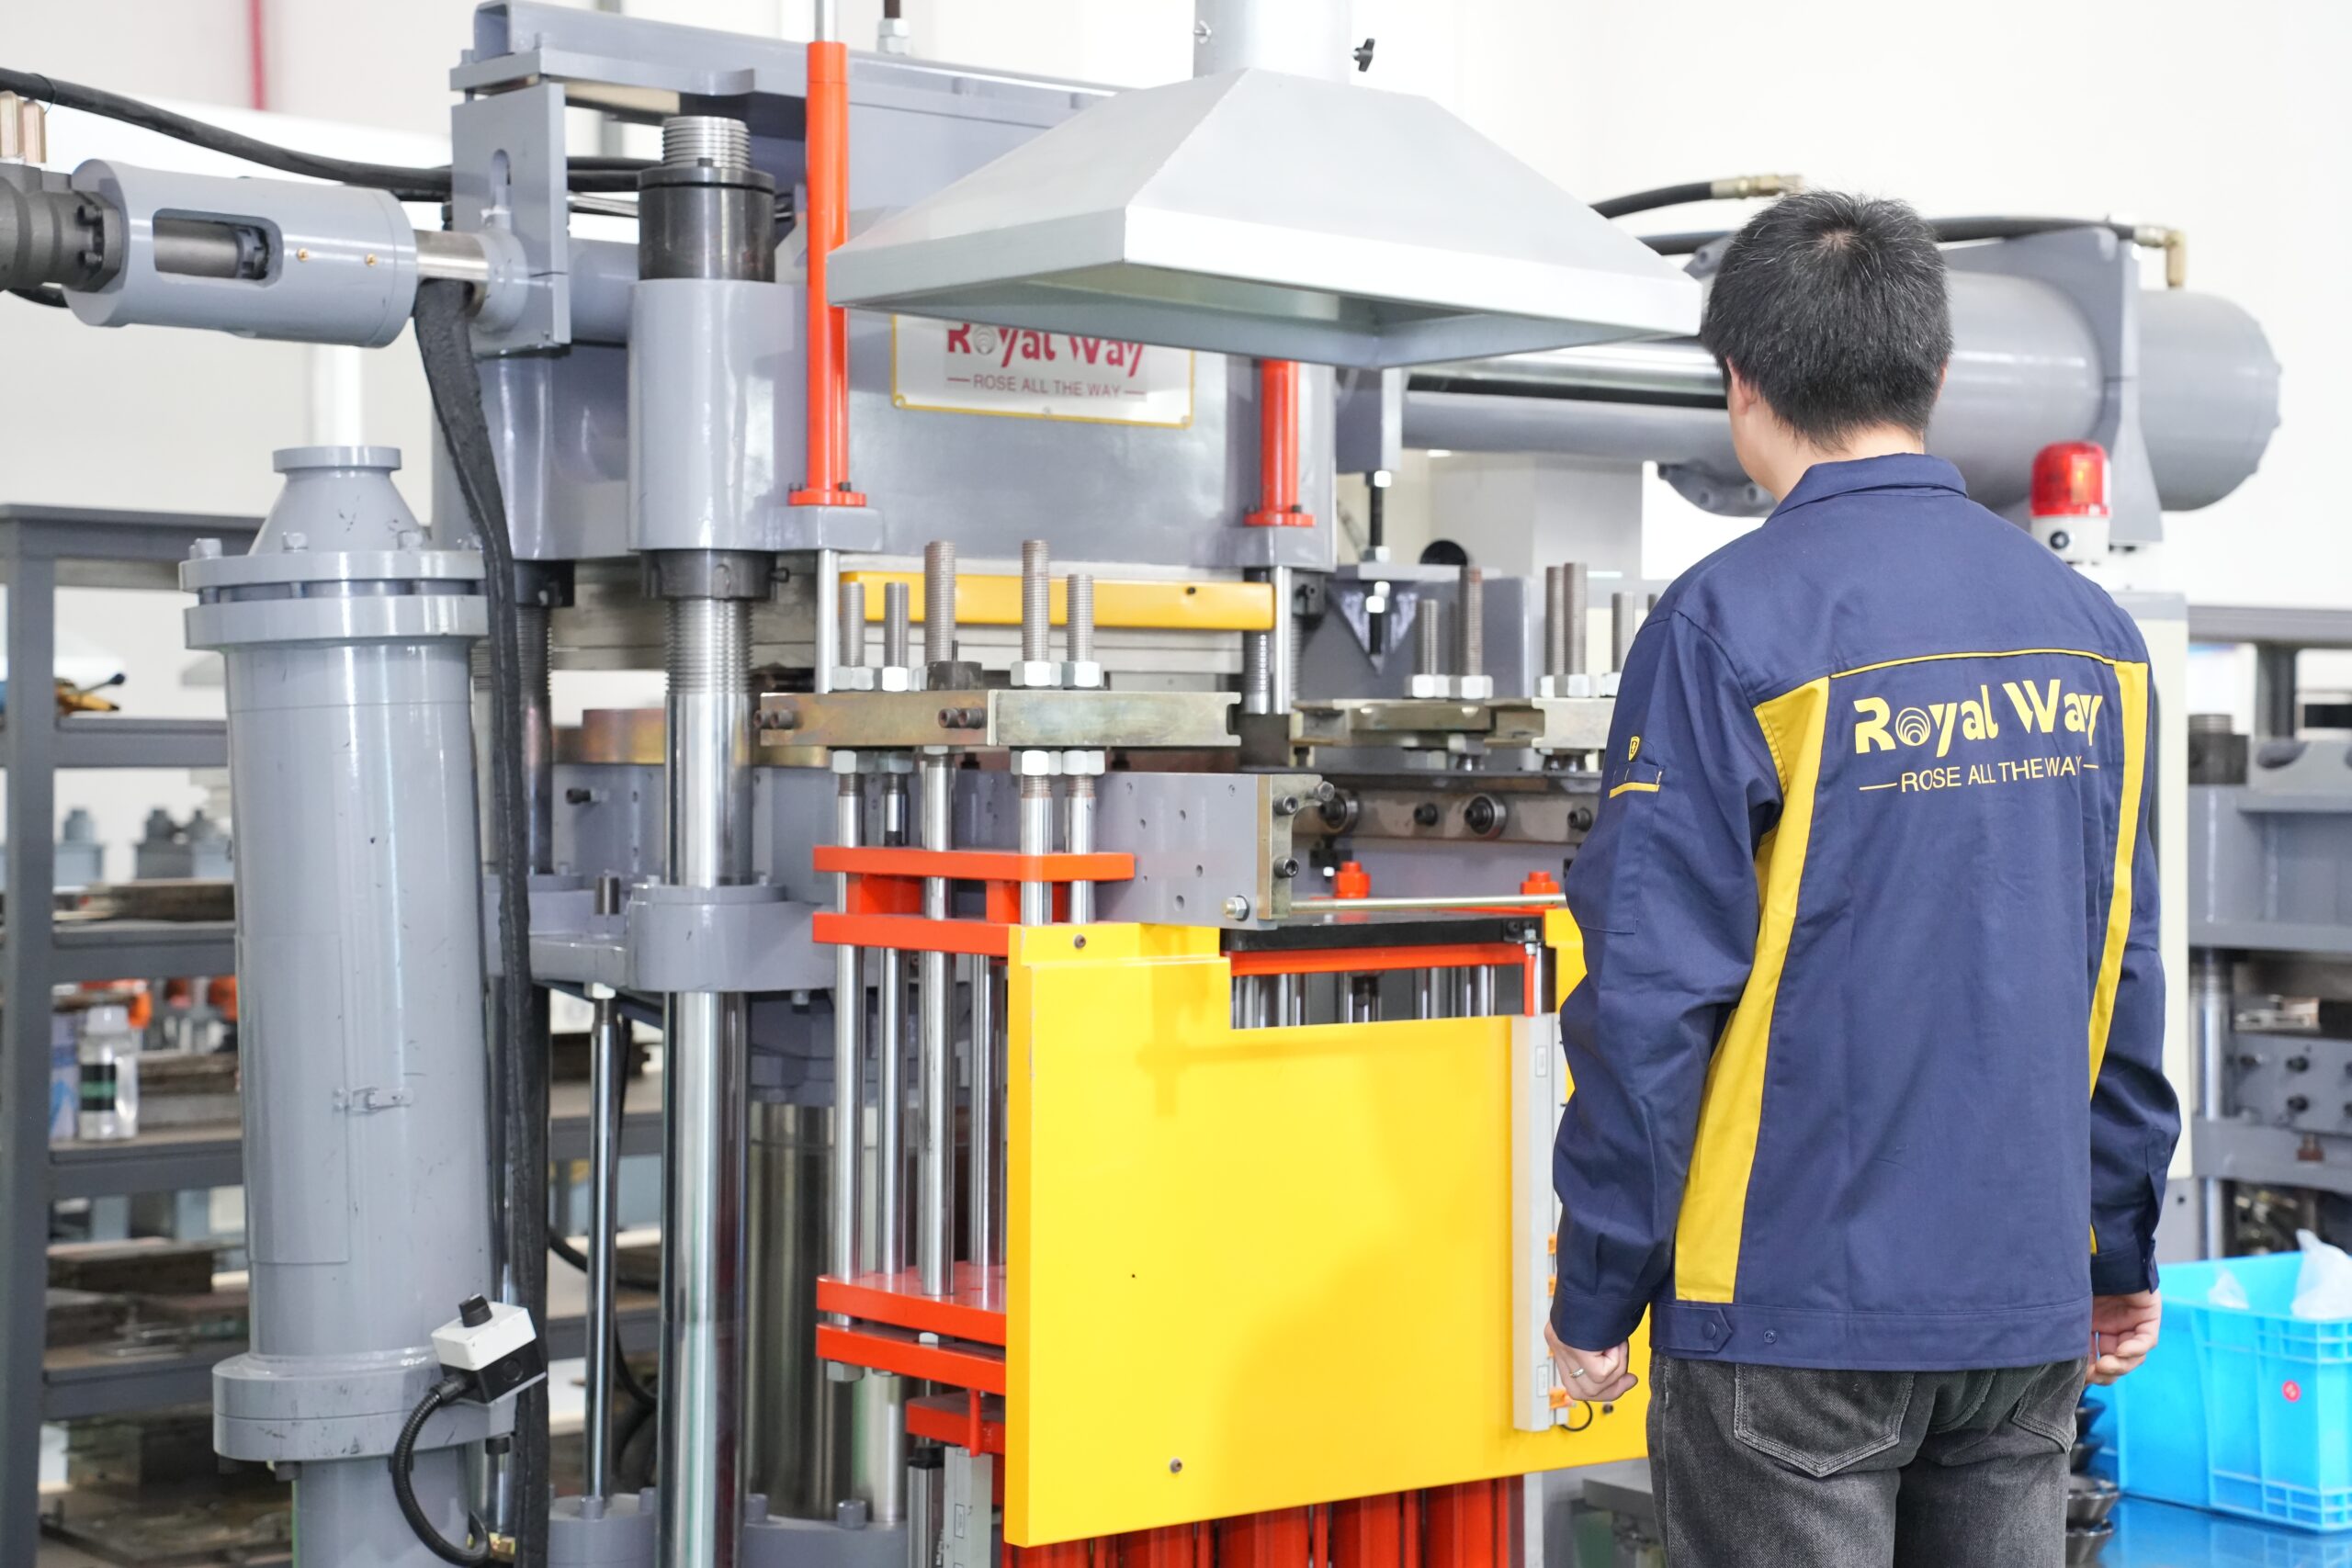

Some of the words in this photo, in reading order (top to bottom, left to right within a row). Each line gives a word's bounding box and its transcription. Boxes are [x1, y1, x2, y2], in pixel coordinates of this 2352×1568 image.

[948, 323, 1056, 367] Royal
[1069, 335, 1143, 377] Way
[974, 373, 1016, 392] ROSE
[1021, 378, 1048, 394] ALL
[1054, 380, 1082, 396] THE
[1087, 383, 1121, 398] WAY
[1853, 684, 1998, 758] Royal
[2001, 679, 2103, 747] Way
[1901, 766, 1962, 793] ROSE
[1968, 764, 1996, 784] ALL
[1998, 758, 2043, 783] THE
[2045, 755, 2083, 779] WAY
